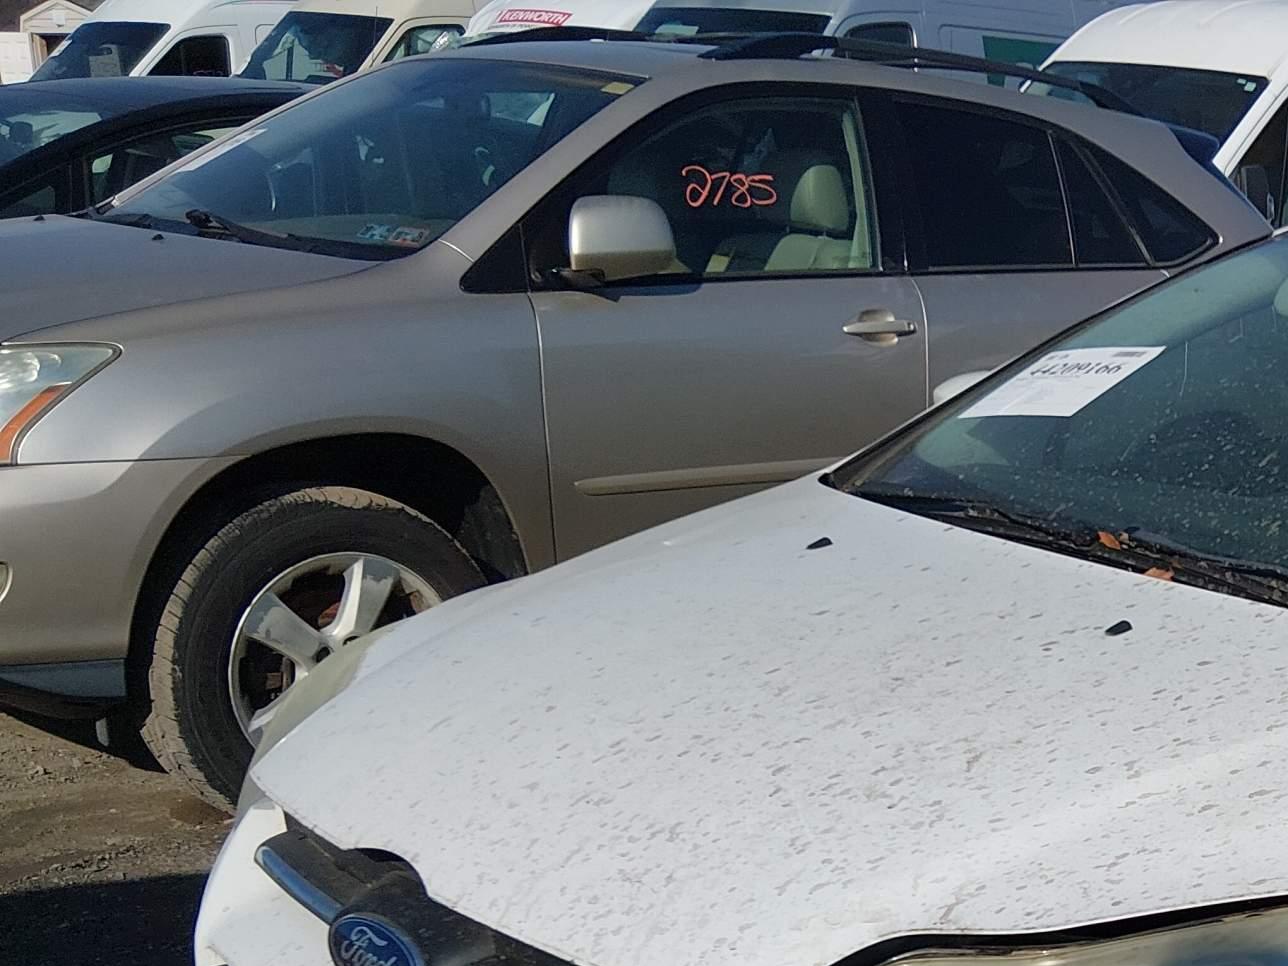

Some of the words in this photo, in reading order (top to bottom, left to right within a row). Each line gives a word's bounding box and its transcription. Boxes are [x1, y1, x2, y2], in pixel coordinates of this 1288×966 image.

[502, 9, 569, 25] KENWORTH
[682, 165, 777, 208] 2785
[1029, 361, 1123, 377] 44209166
